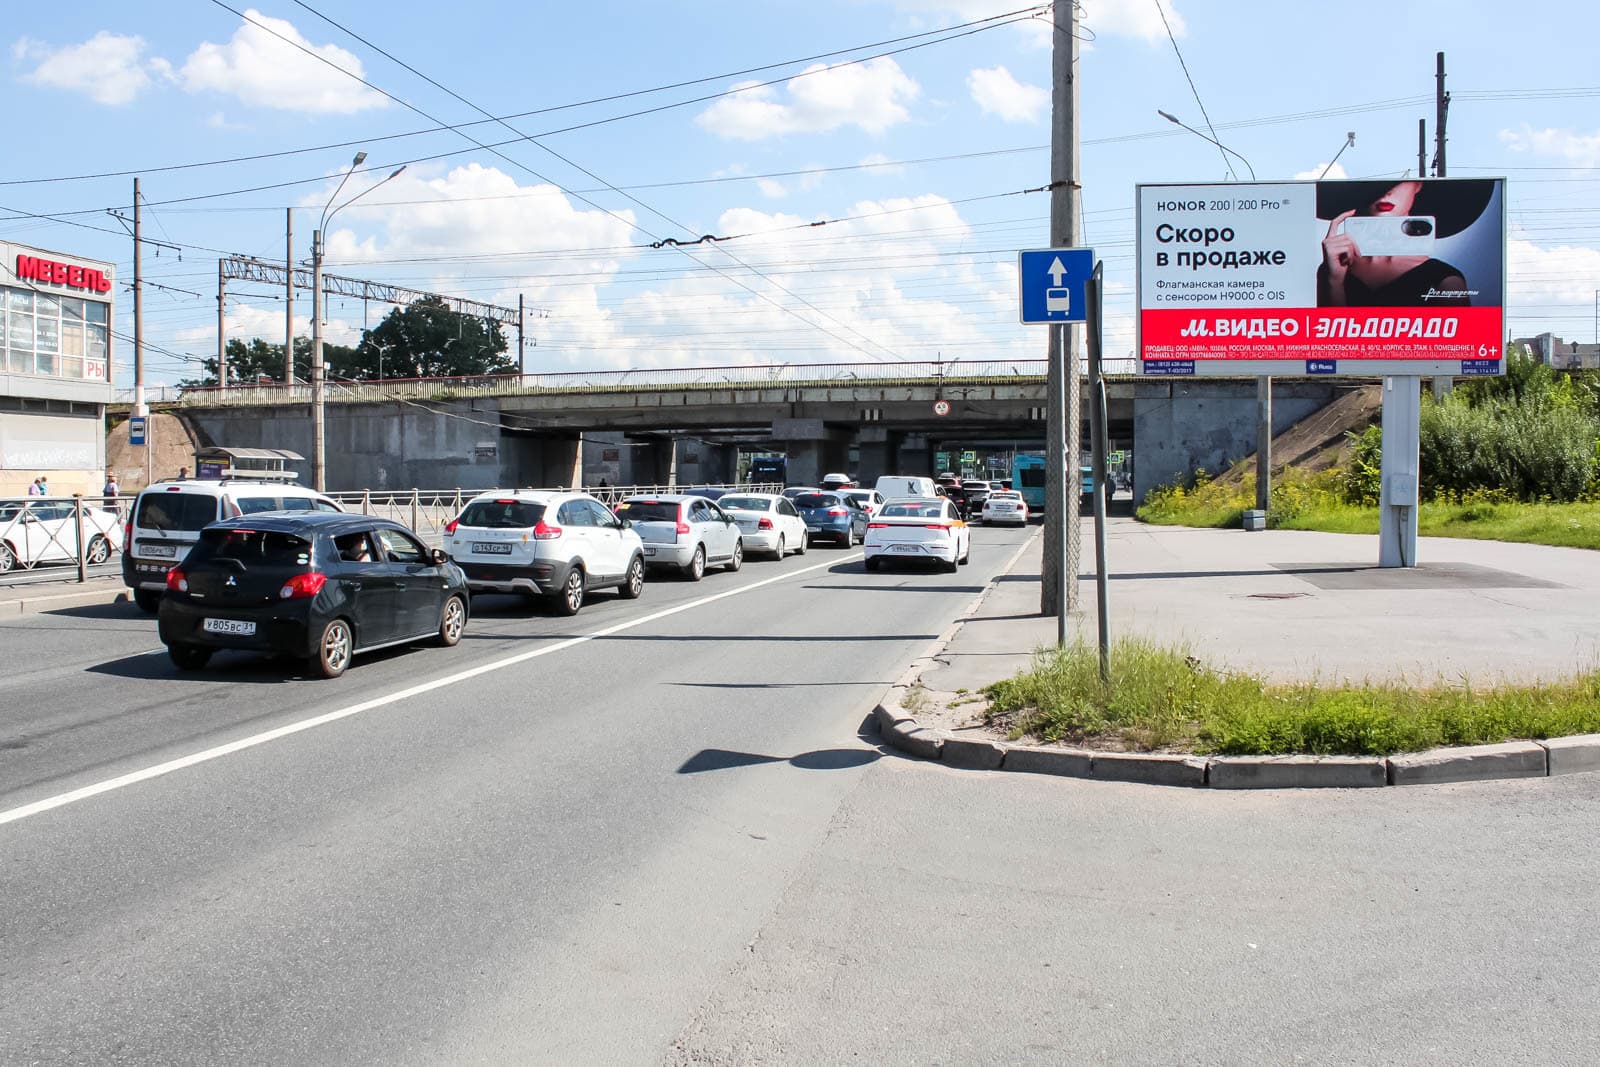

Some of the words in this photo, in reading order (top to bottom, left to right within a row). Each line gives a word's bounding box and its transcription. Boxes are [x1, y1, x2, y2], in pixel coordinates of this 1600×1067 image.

[1157, 201, 1206, 211] HONOR
[1210, 200, 1231, 211] 200
[1238, 199, 1258, 210] 200
[1261, 199, 1280, 210] Pro
[1156, 223, 1235, 247] Скоро
[1156, 252, 1169, 267] в
[1177, 249, 1287, 271] продаже
[16, 254, 112, 292] МЕБЕЛЬ
[1156, 280, 1225, 290] Флагманская
[1227, 280, 1266, 290] камера
[1156, 294, 1163, 302] с
[1165, 293, 1218, 303] сенсором
[1220, 291, 1256, 301] H9000
[1258, 293, 1265, 301] с
[1267, 290, 1286, 301] OIS
[1312, 317, 1459, 339] ЭЛЬДОРАДО
[1478, 344, 1497, 357] 6+
[207, 620, 242, 632] У805ВС
[244, 622, 254, 631] 31
